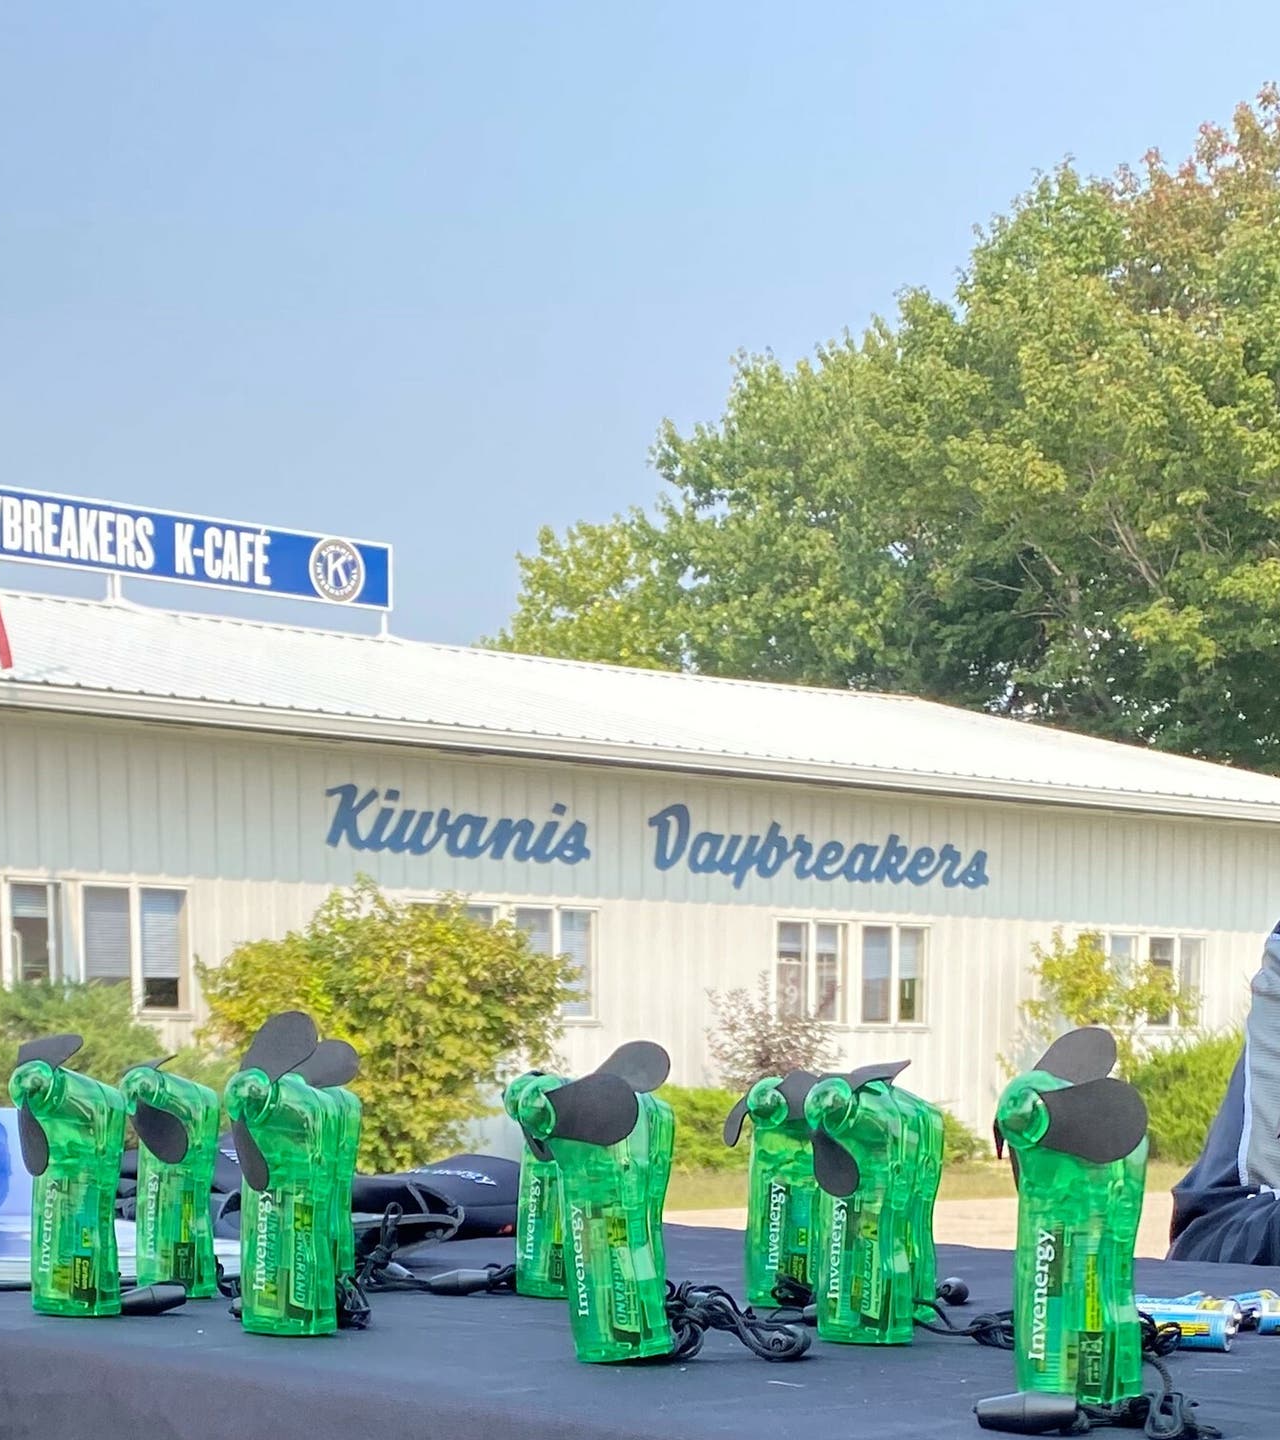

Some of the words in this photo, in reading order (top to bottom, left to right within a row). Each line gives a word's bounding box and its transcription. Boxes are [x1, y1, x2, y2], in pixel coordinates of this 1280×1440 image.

[175, 522, 272, 586] K-CAFÉ
[325, 784, 591, 865] Kiwanis
[648, 803, 990, 889] Daybreakers
[37, 1178, 60, 1274] Invenergy
[146, 1171, 161, 1261] Invenergy
[253, 1190, 273, 1292] Invenergy
[524, 1174, 542, 1261] Invenergy
[570, 1204, 590, 1318] Invenergy
[766, 1182, 787, 1271] Invenergy
[827, 1198, 848, 1300] Invenergy
[1026, 1227, 1057, 1362] Invenergy
